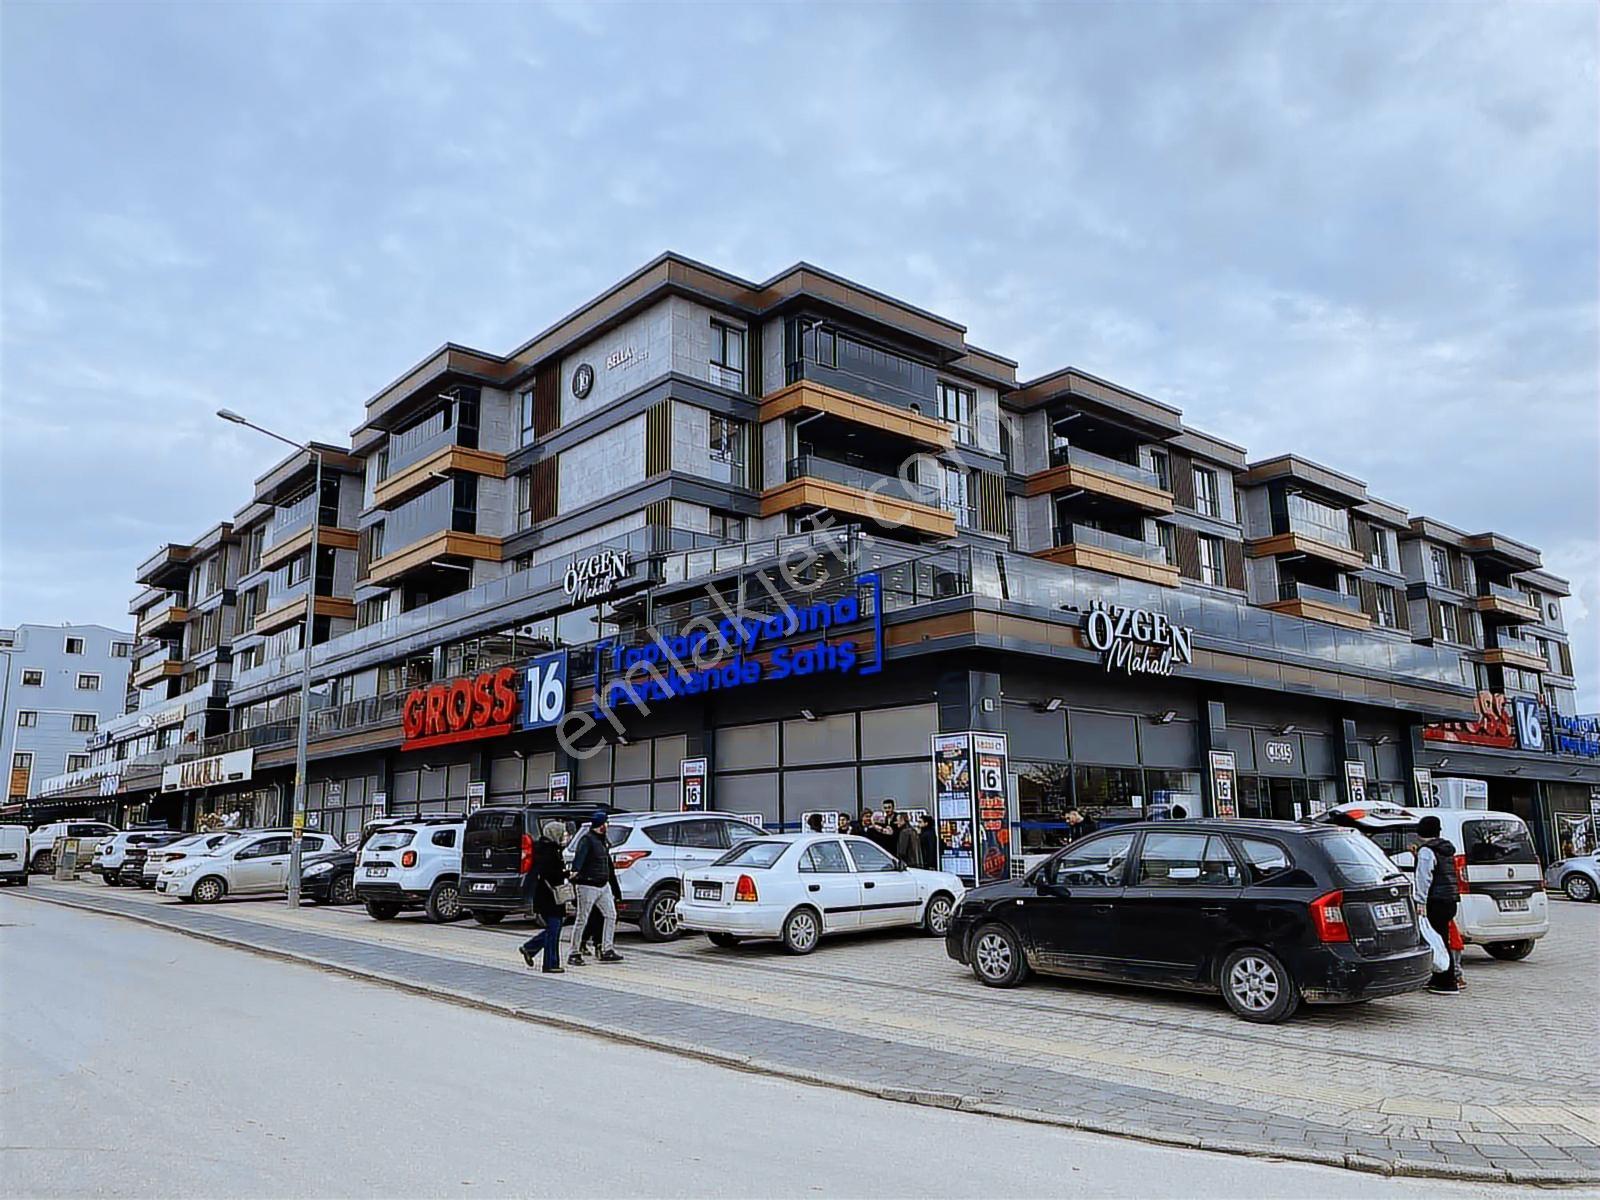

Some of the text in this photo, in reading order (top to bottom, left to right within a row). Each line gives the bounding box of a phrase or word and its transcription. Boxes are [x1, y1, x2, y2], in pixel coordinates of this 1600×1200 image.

[564, 549, 631, 595] ÖZGEN
[1088, 598, 1193, 664] ÖZGEN
[769, 640, 858, 681] Satış
[403, 660, 564, 739] GROSS 16
[1516, 701, 1544, 749] 16
